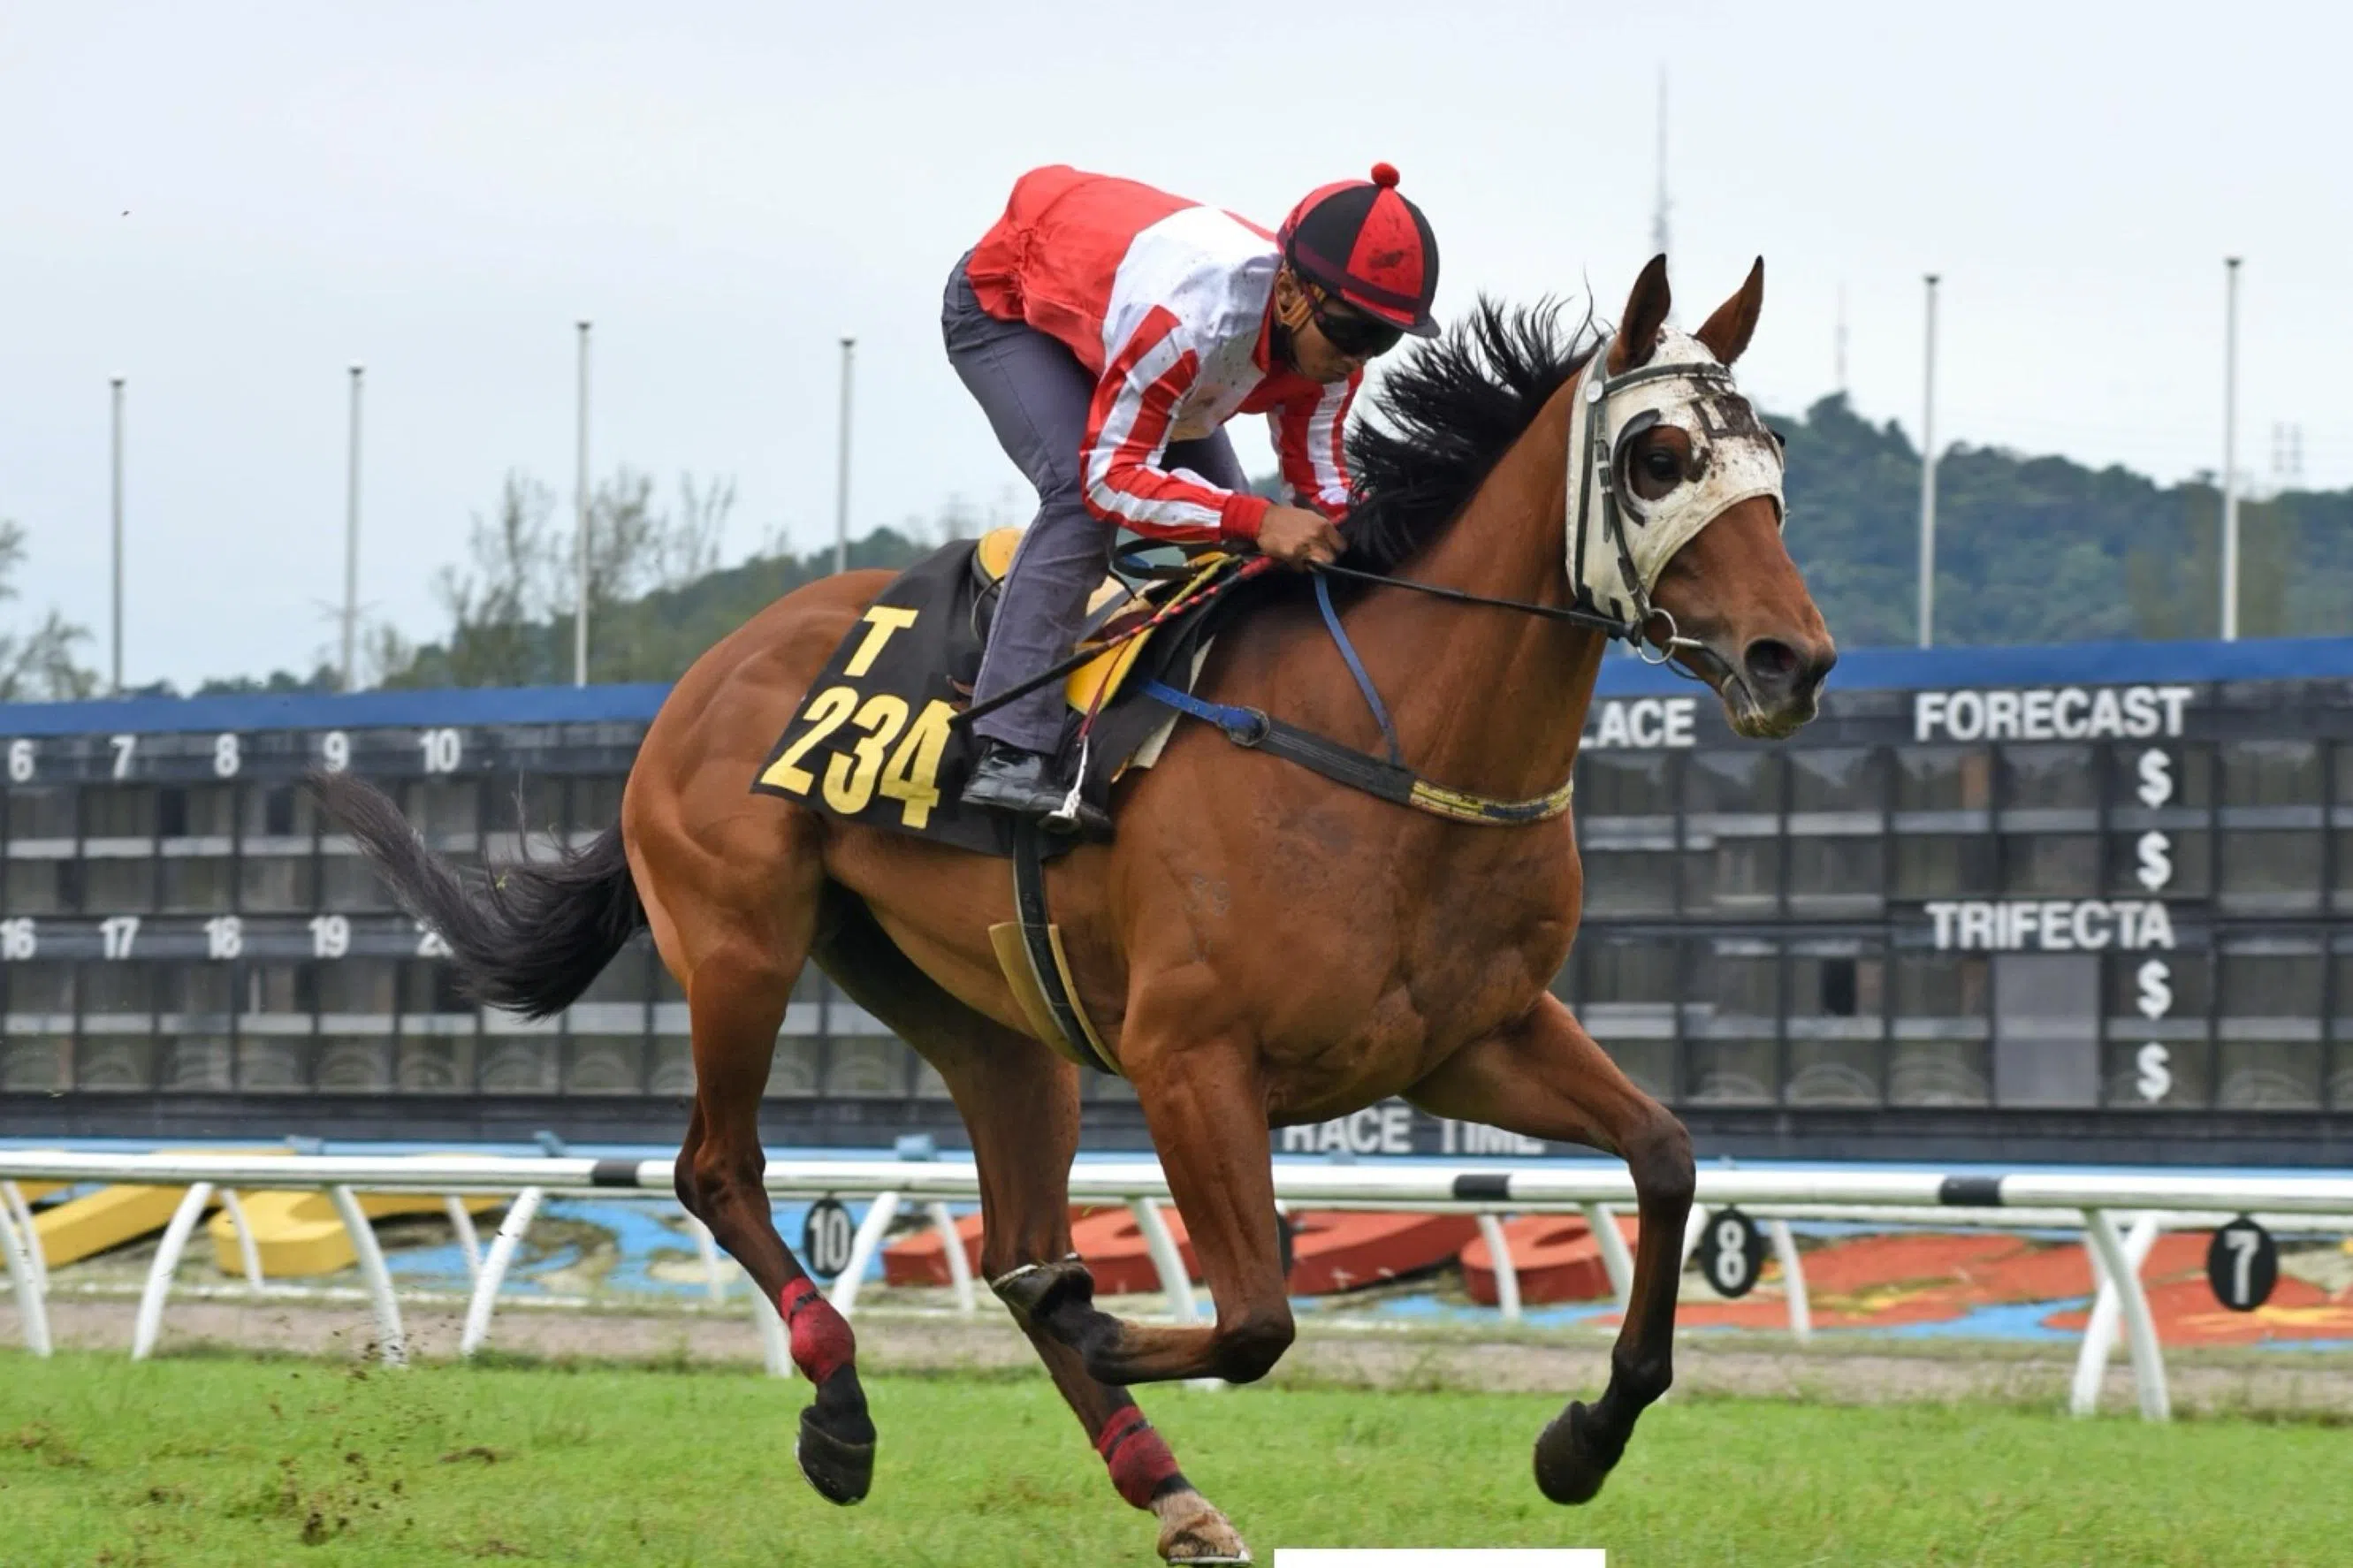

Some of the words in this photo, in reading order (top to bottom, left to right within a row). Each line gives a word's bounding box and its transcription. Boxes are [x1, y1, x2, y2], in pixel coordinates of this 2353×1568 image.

[843, 604, 919, 678] T
[1577, 697, 1696, 750] ACE
[1915, 686, 2195, 742] FORECAST
[8, 738, 34, 782] 6
[110, 735, 137, 780] 7
[214, 733, 240, 778] 8
[322, 731, 350, 773] 9
[417, 729, 462, 773] 10
[760, 685, 958, 831] 234
[2137, 749, 2172, 809] $
[2137, 831, 2172, 891] $
[0, 917, 37, 960] 16
[99, 917, 140, 960] 17
[203, 916, 244, 959] 18
[308, 915, 350, 958] 19
[1924, 901, 2175, 950] TRIFECTA
[2137, 959, 2172, 1020] $
[2136, 1042, 2172, 1103] $
[809, 1206, 850, 1272] 10
[1716, 1219, 1747, 1289] 8
[2225, 1229, 2260, 1305] 7
